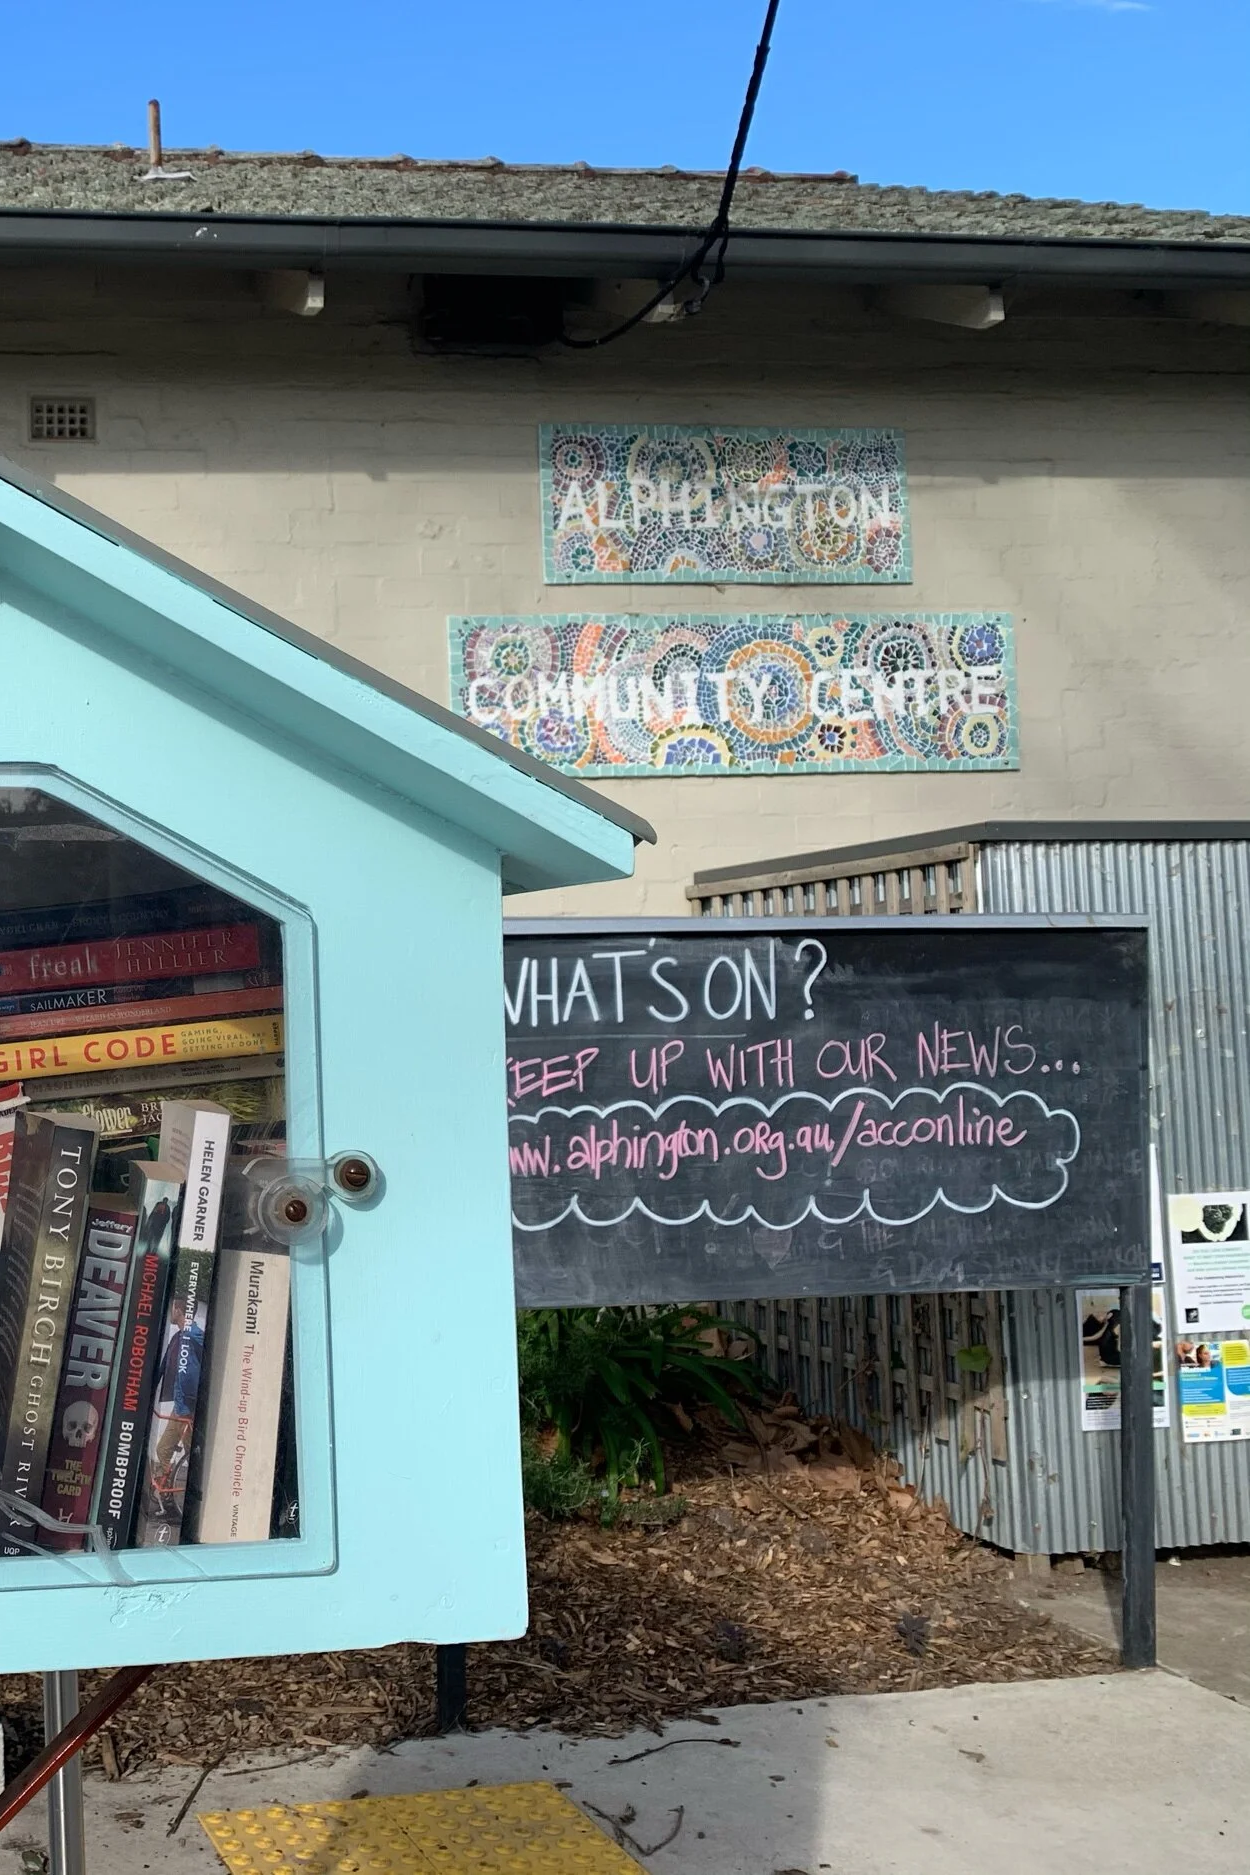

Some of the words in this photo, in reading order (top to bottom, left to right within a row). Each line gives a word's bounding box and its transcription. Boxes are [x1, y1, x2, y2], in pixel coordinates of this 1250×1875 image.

[556, 480, 893, 531] ALPHINGTON
[467, 669, 771, 725] COMMUNITY
[810, 665, 1001, 716] CENTRE
[115, 929, 234, 960] JENNIFER
[127, 949, 228, 974] HILLIER
[30, 989, 108, 1013] SAILMAKER
[84, 1034, 177, 1063] CODE
[181, 1027, 223, 1038] GAMING,
[182, 1036, 213, 1045] GOING
[183, 1043, 223, 1054] GETTING
[506, 1047, 599, 1107] EEP
[631, 1040, 685, 1093] UP
[707, 1038, 795, 1092] WITH
[817, 1032, 897, 1082] OUR
[199, 1140, 216, 1183] HELEN
[45, 1143, 83, 1247] TONY
[191, 1185, 210, 1242] GARNER
[91, 1218, 134, 1233] Jeffery
[135, 1253, 159, 1321] MICHAEL
[181, 1261, 200, 1332] EVERYWHERE
[243, 1260, 265, 1335] Murakami
[29, 1253, 66, 1366] BIRCH
[65, 1233, 133, 1391] DEAVER
[121, 1323, 148, 1412] ROBOTHAM
[176, 1343, 190, 1374] LOOK
[241, 1343, 254, 1364] The
[235, 1367, 252, 1413] Wind-up
[19, 1375, 44, 1451] GHOST
[235, 1417, 248, 1441] Bird
[51, 1469, 92, 1485] TWELFTH
[65, 1460, 83, 1472] THE
[105, 1420, 135, 1520] BOMBPROOF
[230, 1444, 246, 1497] Chronicle
[8, 1460, 32, 1528] RIV
[57, 1484, 82, 1497] CARD
[229, 1504, 239, 1537] VINTAGE
[3, 1546, 20, 1555] UQP
